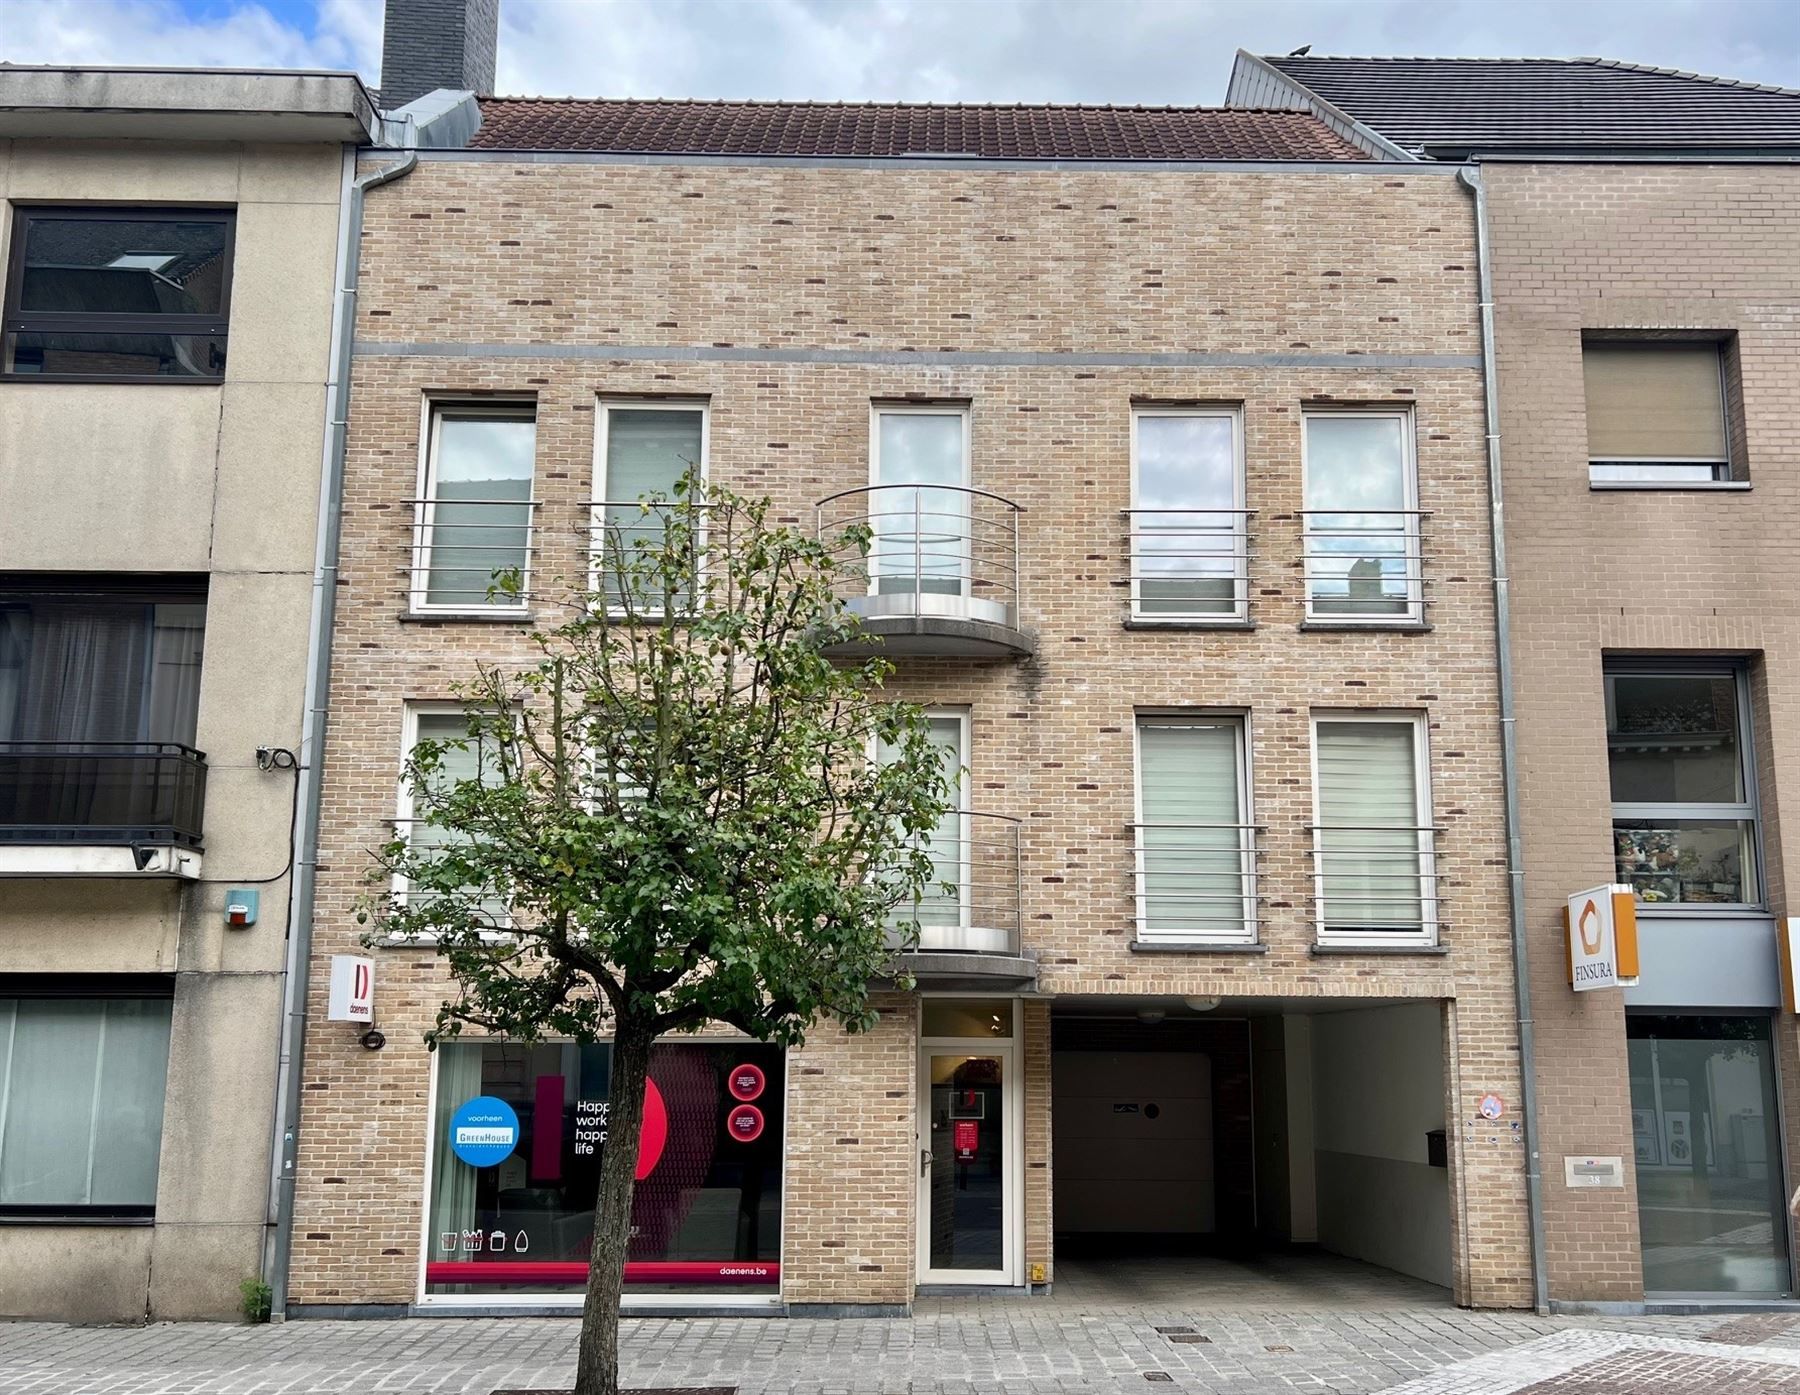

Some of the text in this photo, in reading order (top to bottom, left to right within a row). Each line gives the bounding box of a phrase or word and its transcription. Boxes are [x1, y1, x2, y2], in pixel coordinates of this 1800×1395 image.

[1576, 962, 1612, 981] FINSURA
[577, 1100, 610, 1115] Happ
[467, 1114, 503, 1122] voorheen
[576, 1114, 607, 1126] work
[575, 1128, 608, 1143] happ
[575, 1142, 594, 1154] life
[1588, 1175, 1600, 1184] 38
[720, 1266, 767, 1275] daenens.be
